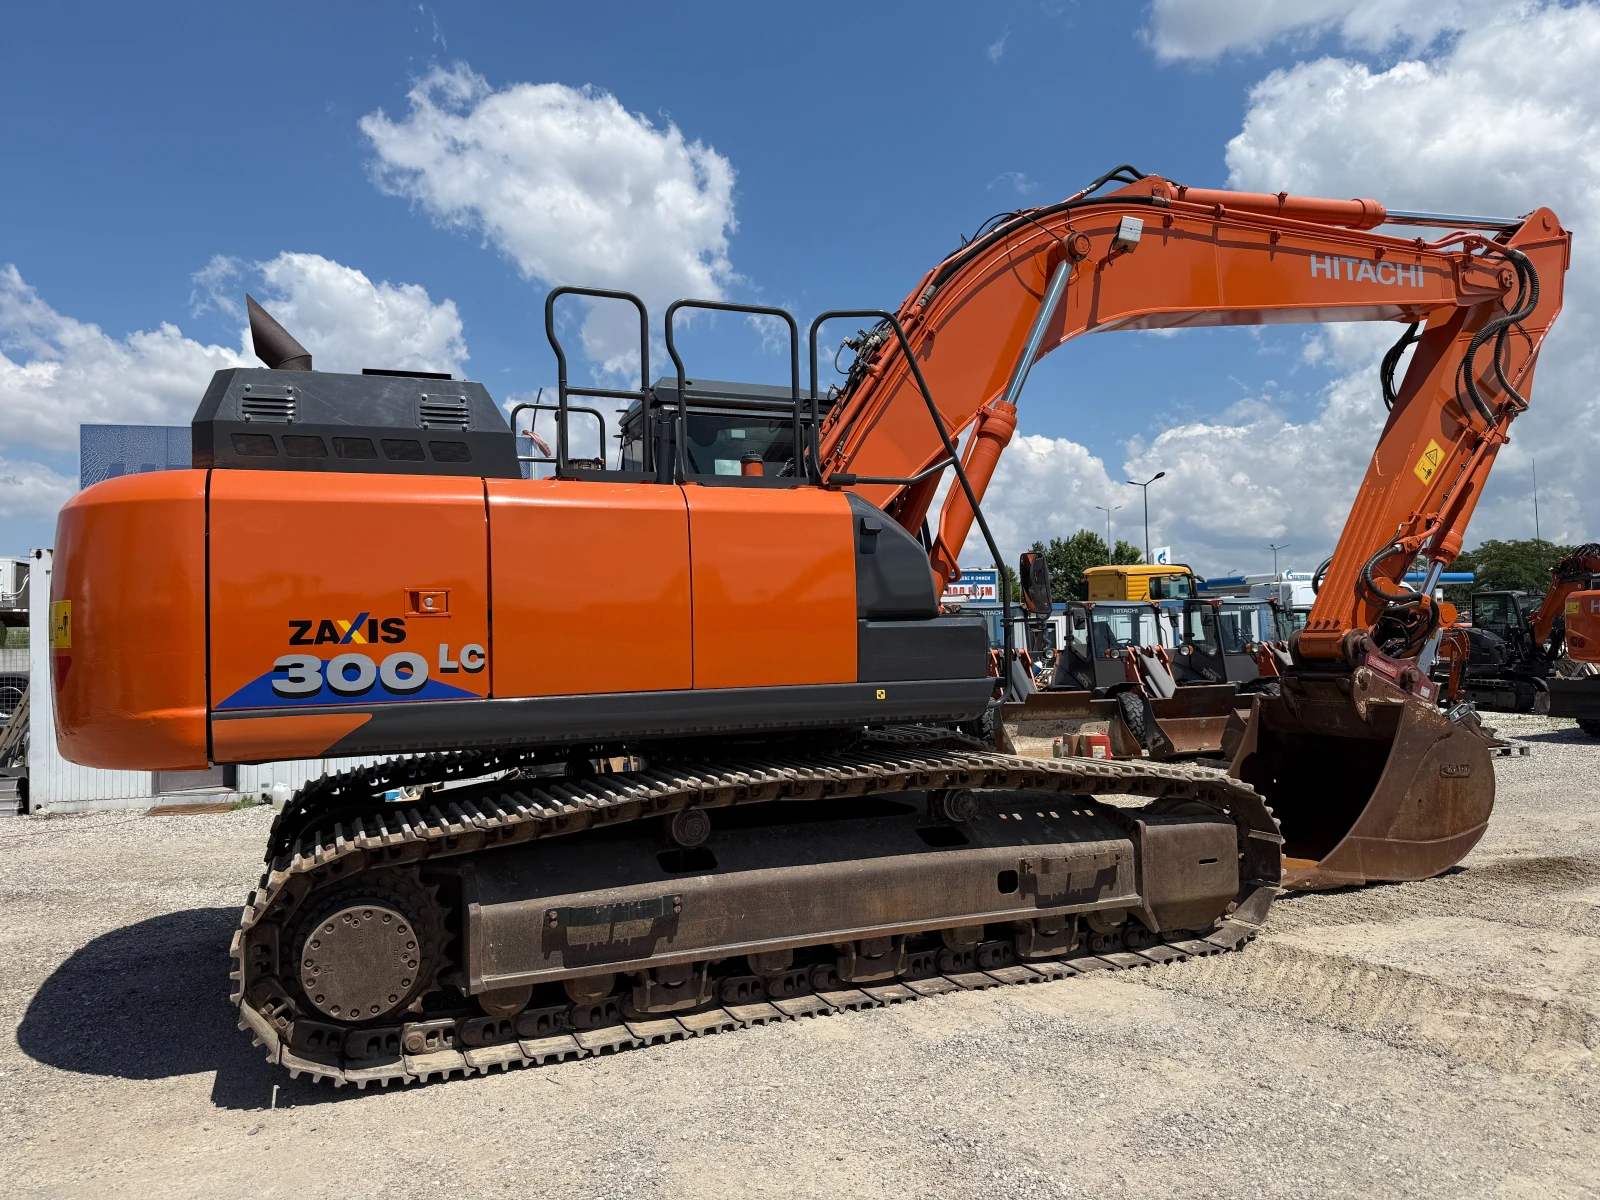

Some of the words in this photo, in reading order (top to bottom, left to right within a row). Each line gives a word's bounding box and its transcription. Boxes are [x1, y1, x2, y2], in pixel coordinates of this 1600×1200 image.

[1310, 254, 1424, 288] HITACHI
[288, 612, 407, 646] ZAXIS
[271, 651, 429, 699] 300
[438, 643, 486, 674] LC
